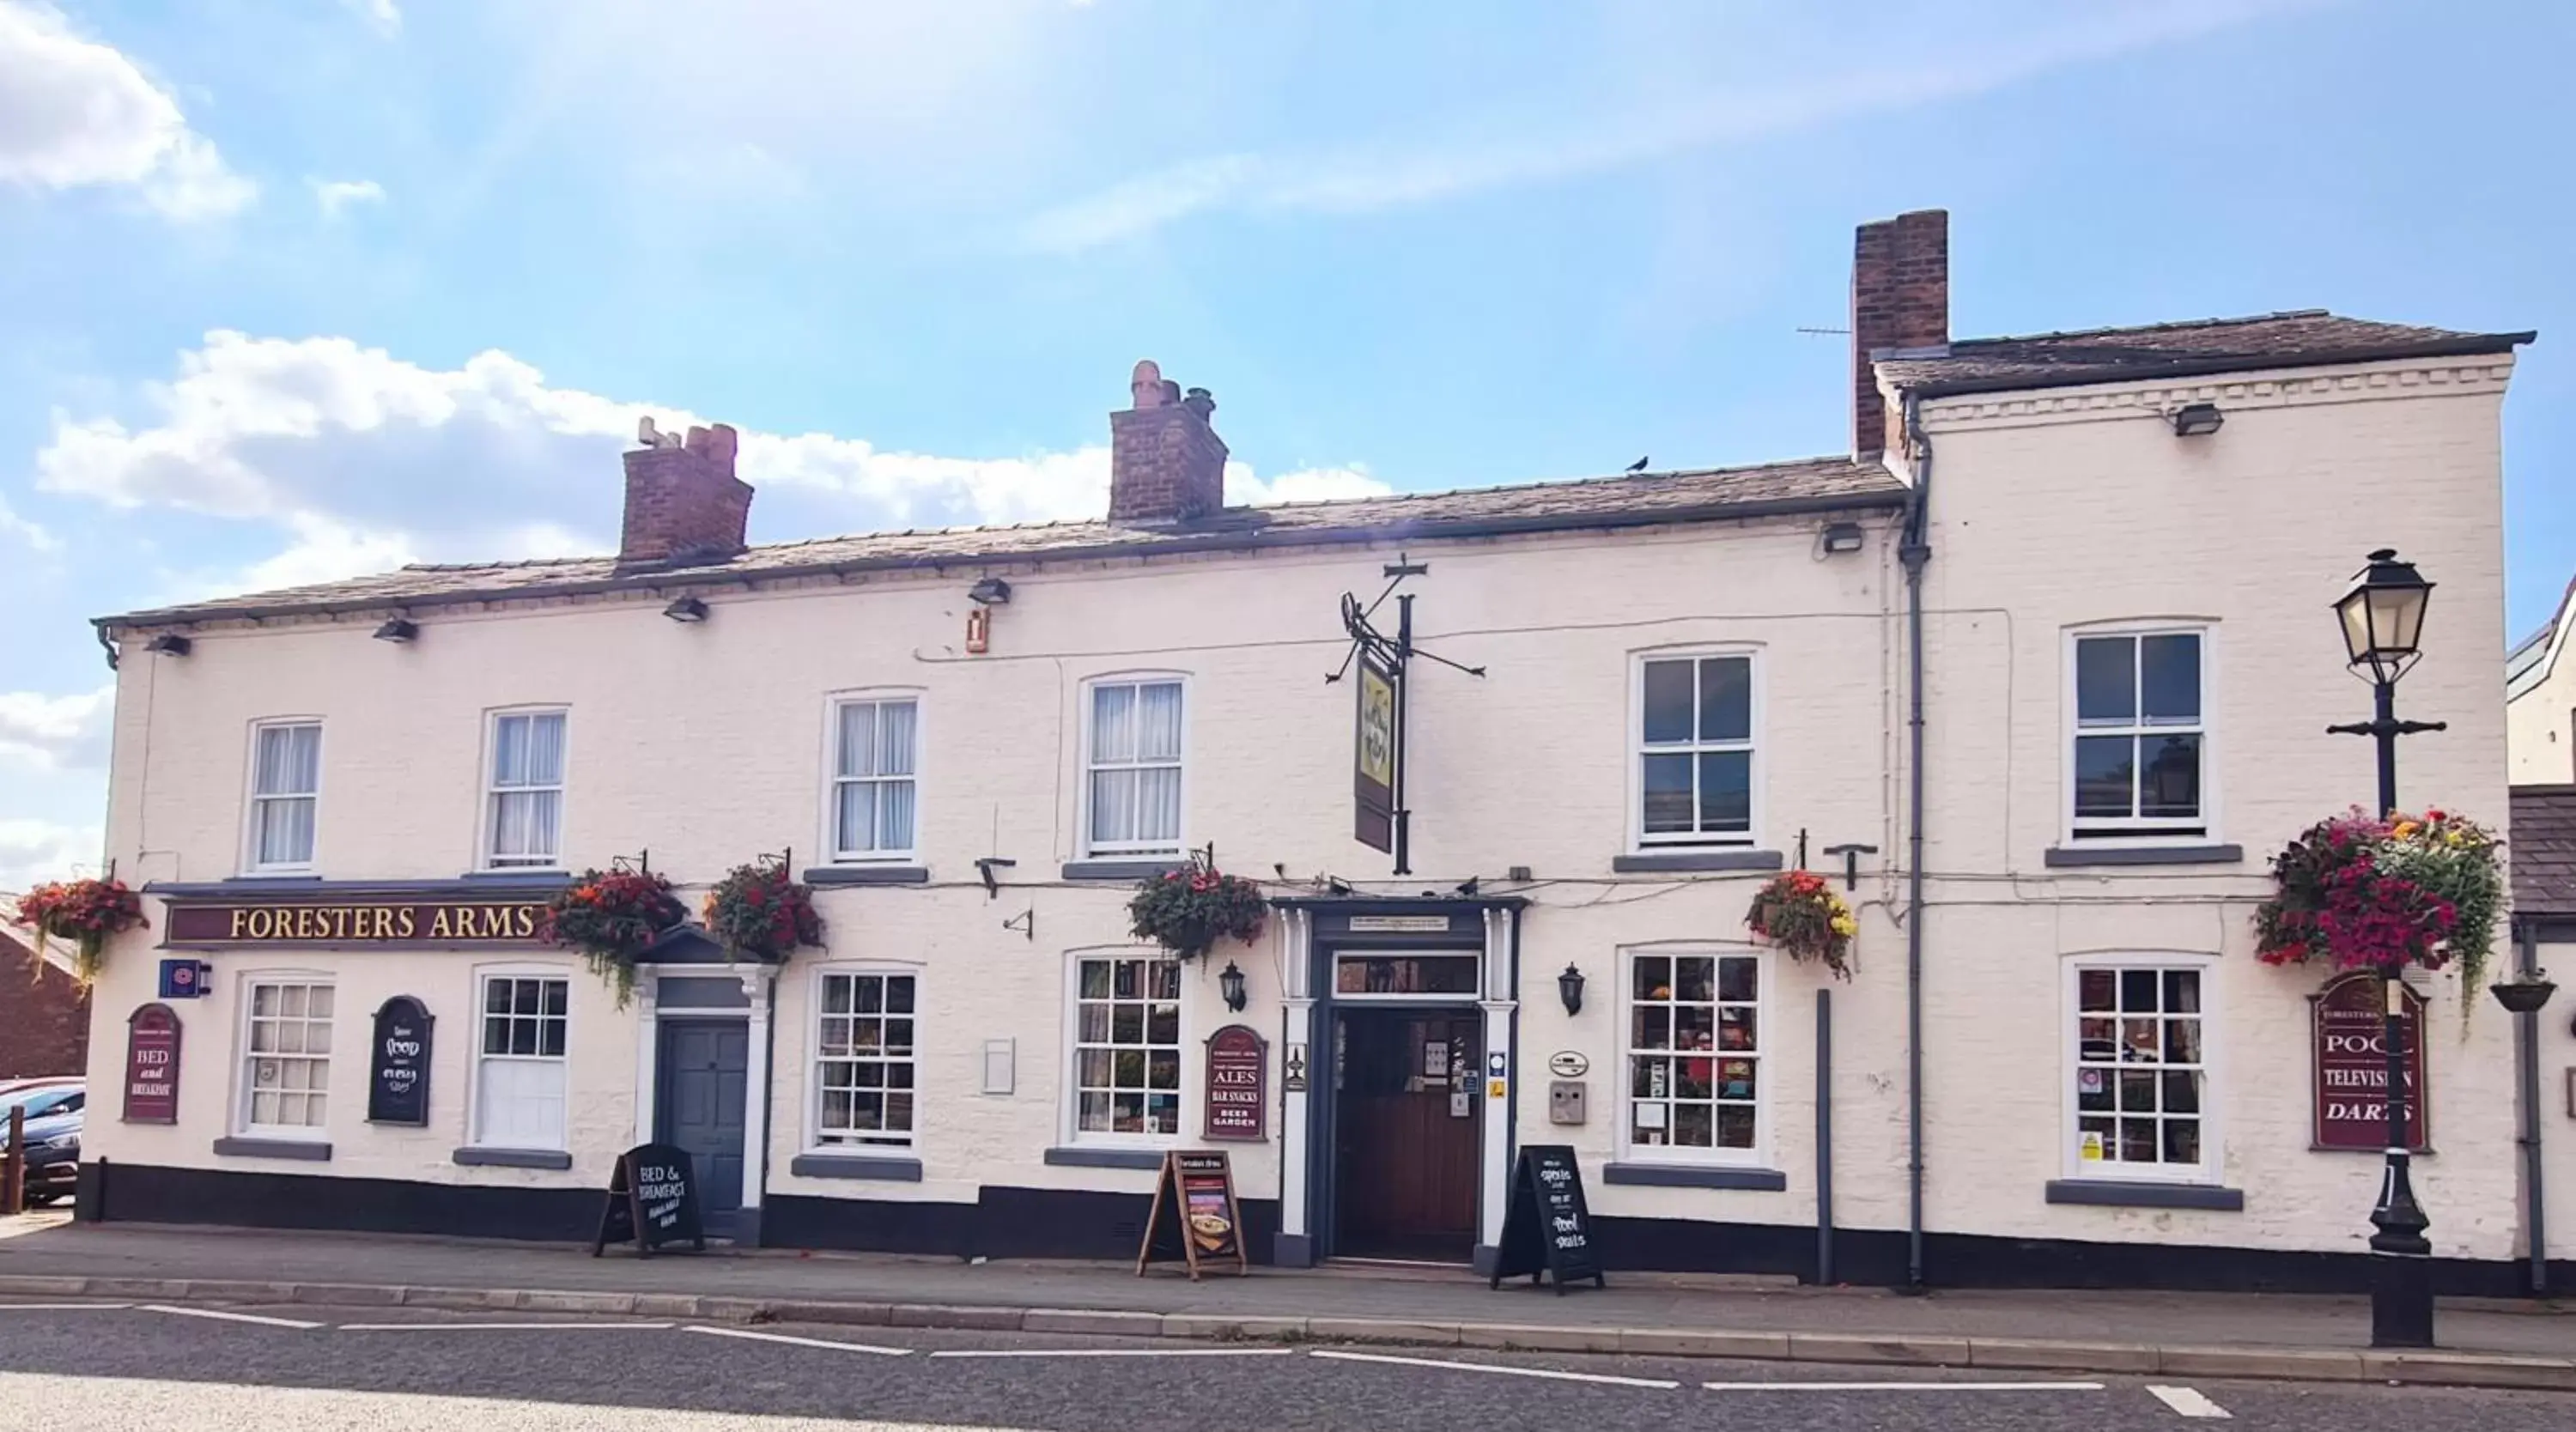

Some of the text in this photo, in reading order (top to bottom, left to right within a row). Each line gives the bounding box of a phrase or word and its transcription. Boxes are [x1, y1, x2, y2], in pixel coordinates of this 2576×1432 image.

[230, 906, 534, 938] FORESTERS ARMS
[137, 1050, 169, 1064] BED
[140, 1066, 164, 1078] and
[1213, 1071, 1256, 1084] ALES
[2324, 1069, 2412, 1087] TELEVISIN
[1212, 1090, 1258, 1103] BAR SNACKS
[1212, 1117, 1256, 1127] GARDEN
[640, 1164, 680, 1182] BED &
